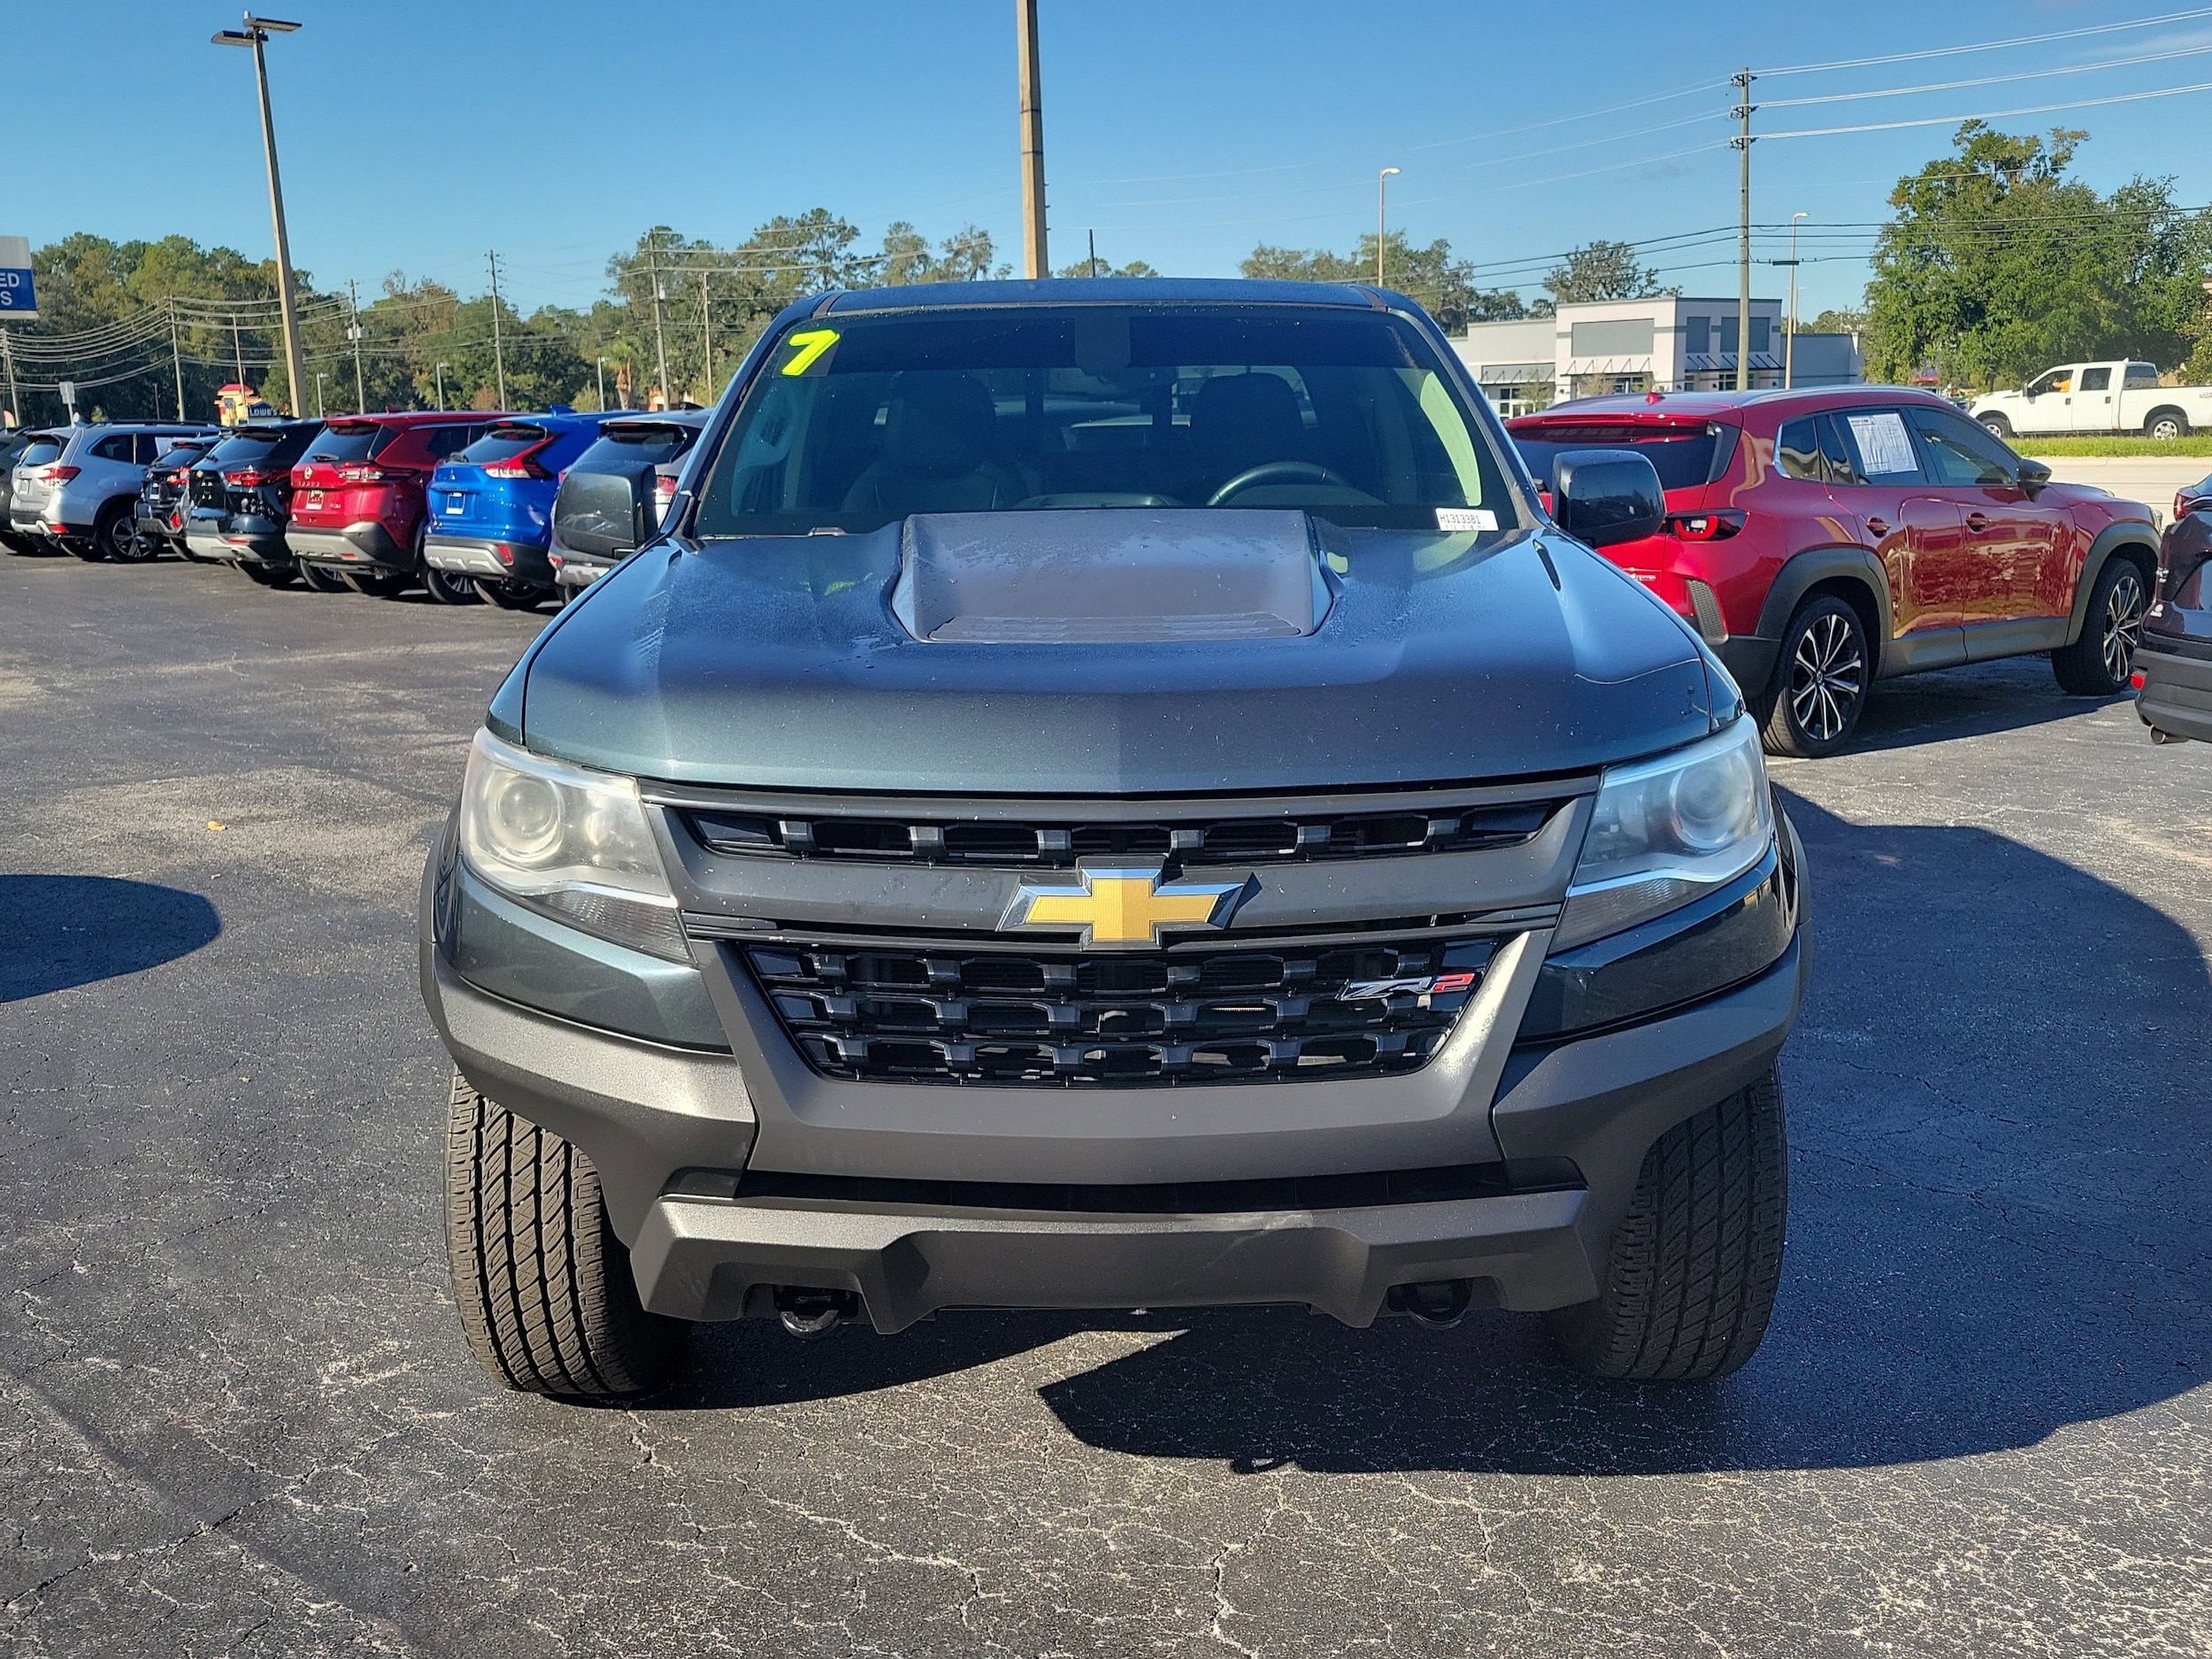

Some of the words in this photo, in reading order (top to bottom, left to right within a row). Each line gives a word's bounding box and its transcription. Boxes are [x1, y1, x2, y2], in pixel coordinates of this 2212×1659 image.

[781, 329, 841, 376] 7
[1439, 513, 1481, 525] H1313381
[1334, 973, 1475, 1002] ZR2
